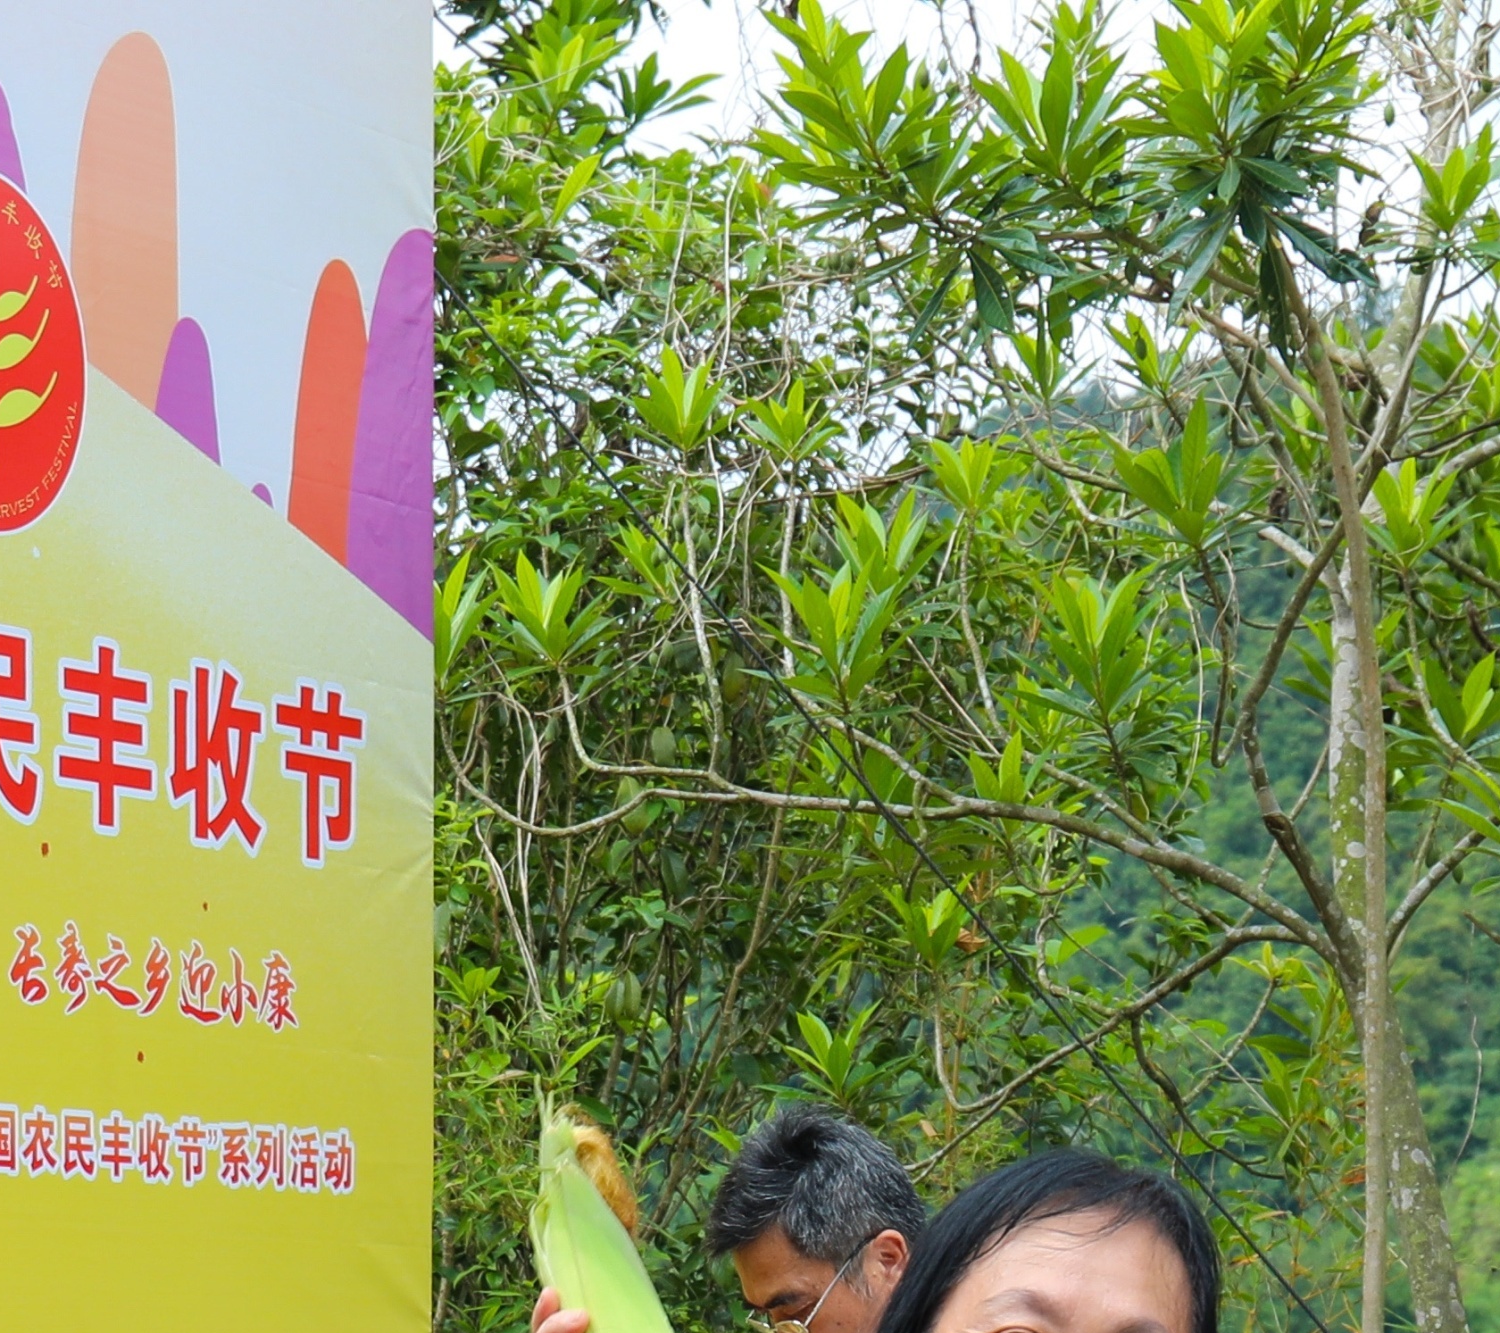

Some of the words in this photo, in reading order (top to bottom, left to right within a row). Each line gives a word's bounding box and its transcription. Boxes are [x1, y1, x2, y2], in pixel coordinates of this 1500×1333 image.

[43, 401, 78, 491] FESTIVAL
[10, 922, 299, 1033] 长寿之乡迎小康
